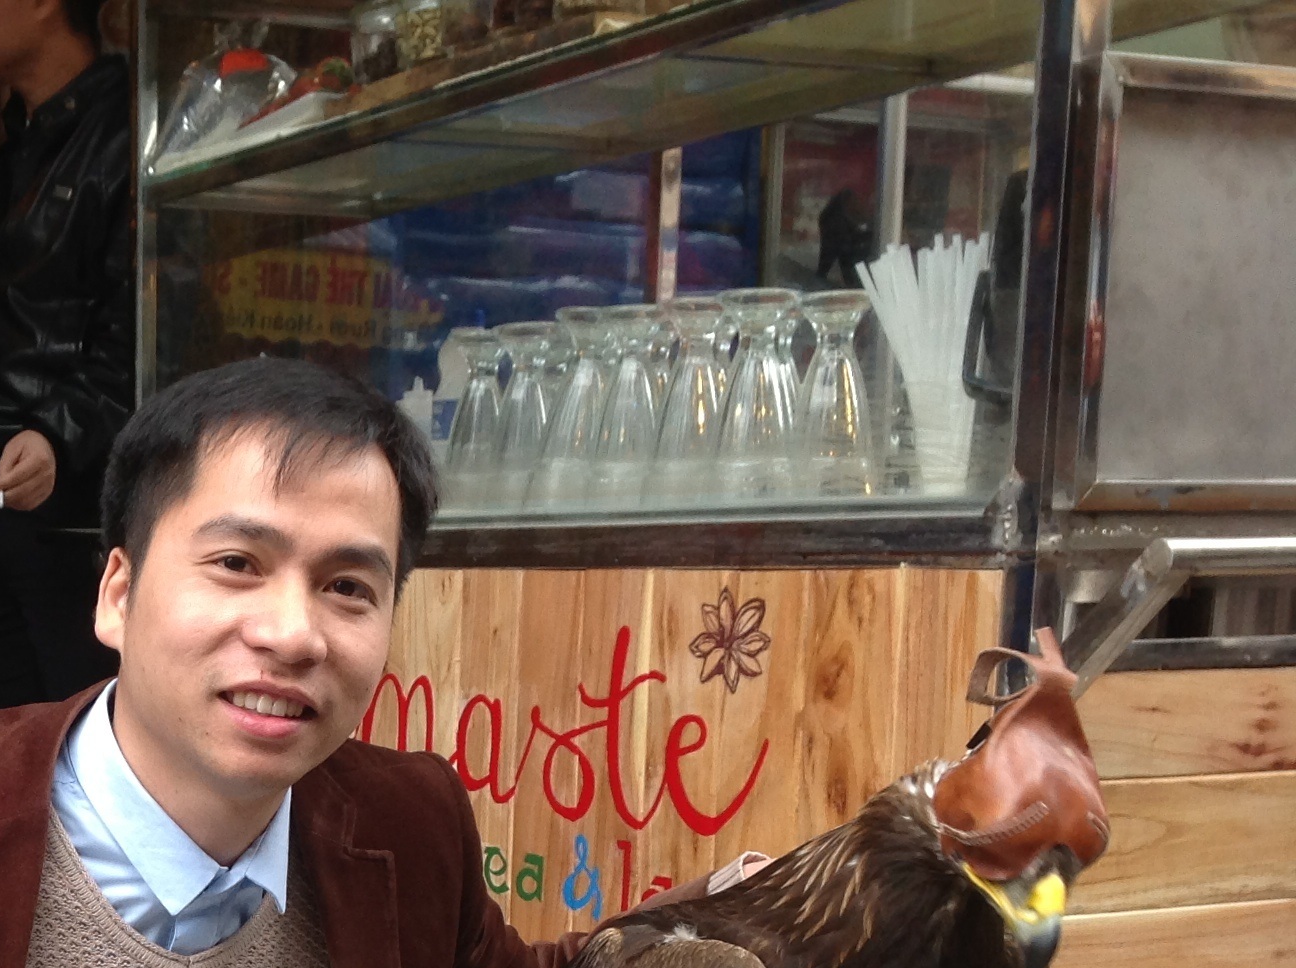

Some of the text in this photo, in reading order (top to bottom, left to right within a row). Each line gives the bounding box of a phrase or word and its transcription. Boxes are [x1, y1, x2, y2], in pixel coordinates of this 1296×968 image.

[354, 625, 770, 836] maste
[484, 846, 545, 903] ea
[562, 833, 602, 921] &
